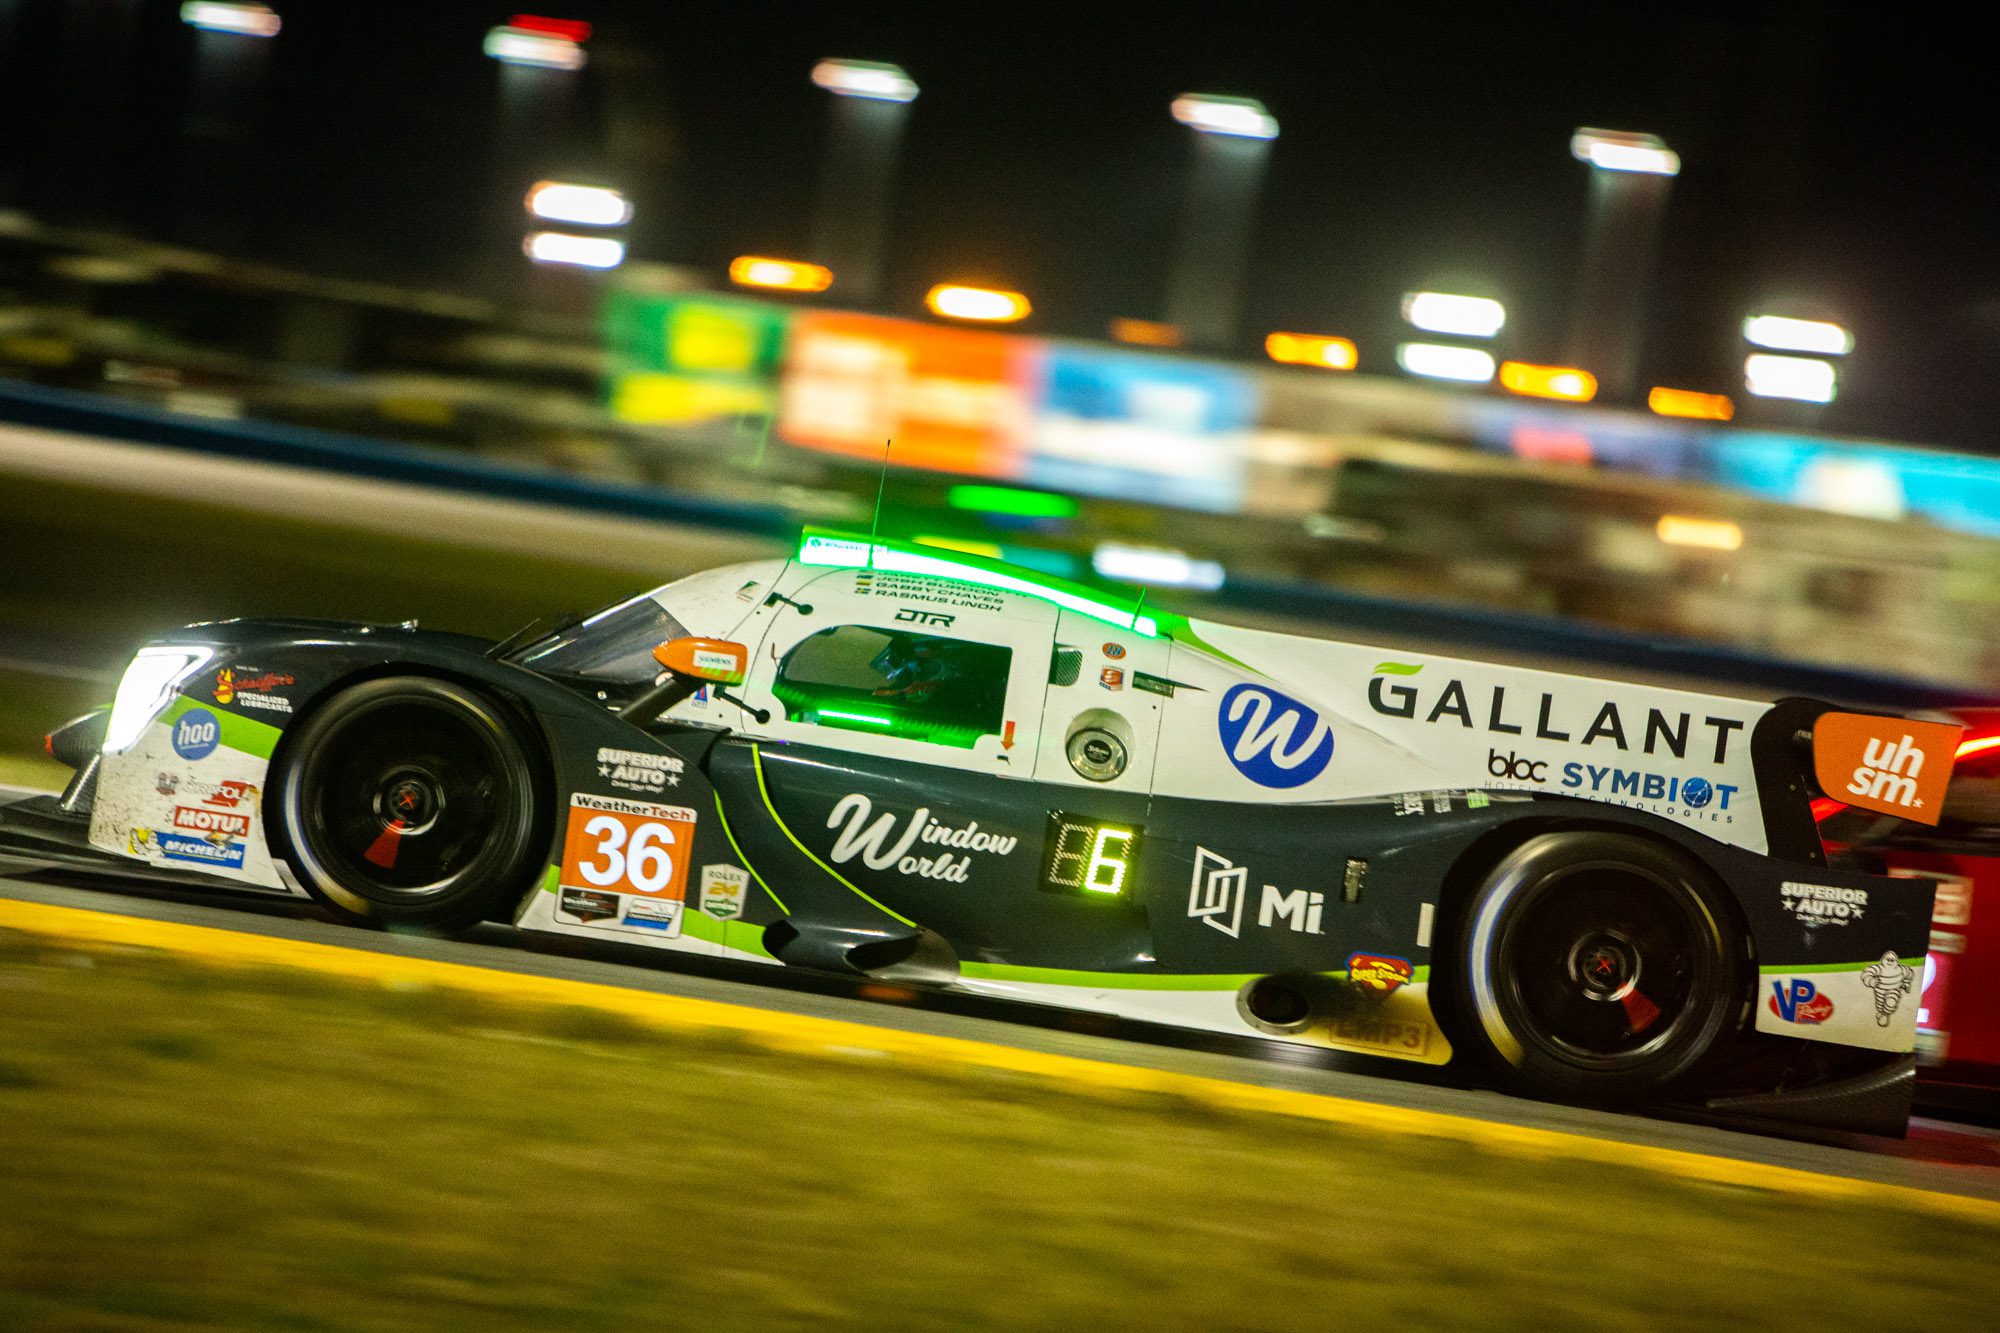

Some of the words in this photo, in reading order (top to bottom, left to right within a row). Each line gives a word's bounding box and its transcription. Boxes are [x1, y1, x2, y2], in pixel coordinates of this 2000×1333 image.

[875, 590, 948, 603] RASMUS
[951, 599, 1001, 612] LINDH
[876, 582, 933, 593] GABBY
[938, 589, 1004, 604] CHAVES
[178, 720, 215, 746] hoo
[1367, 676, 1744, 764] GALLANT
[597, 747, 685, 773] SUPERIOR
[1488, 748, 1548, 783] bloc
[1862, 735, 1925, 779] uh
[610, 764, 666, 785] AUTO
[1561, 762, 1738, 810] SYMBIOT
[177, 807, 246, 834] MOTUL
[575, 795, 690, 820] WeatherTech
[826, 793, 1018, 871] Window
[165, 840, 242, 860] MICHELIN
[578, 815, 675, 892] 36
[1781, 881, 1868, 905] SUPERIOR
[1258, 884, 1324, 934] Mi
[1795, 898, 1850, 917] AUTO
[1772, 979, 1816, 1023] VP
